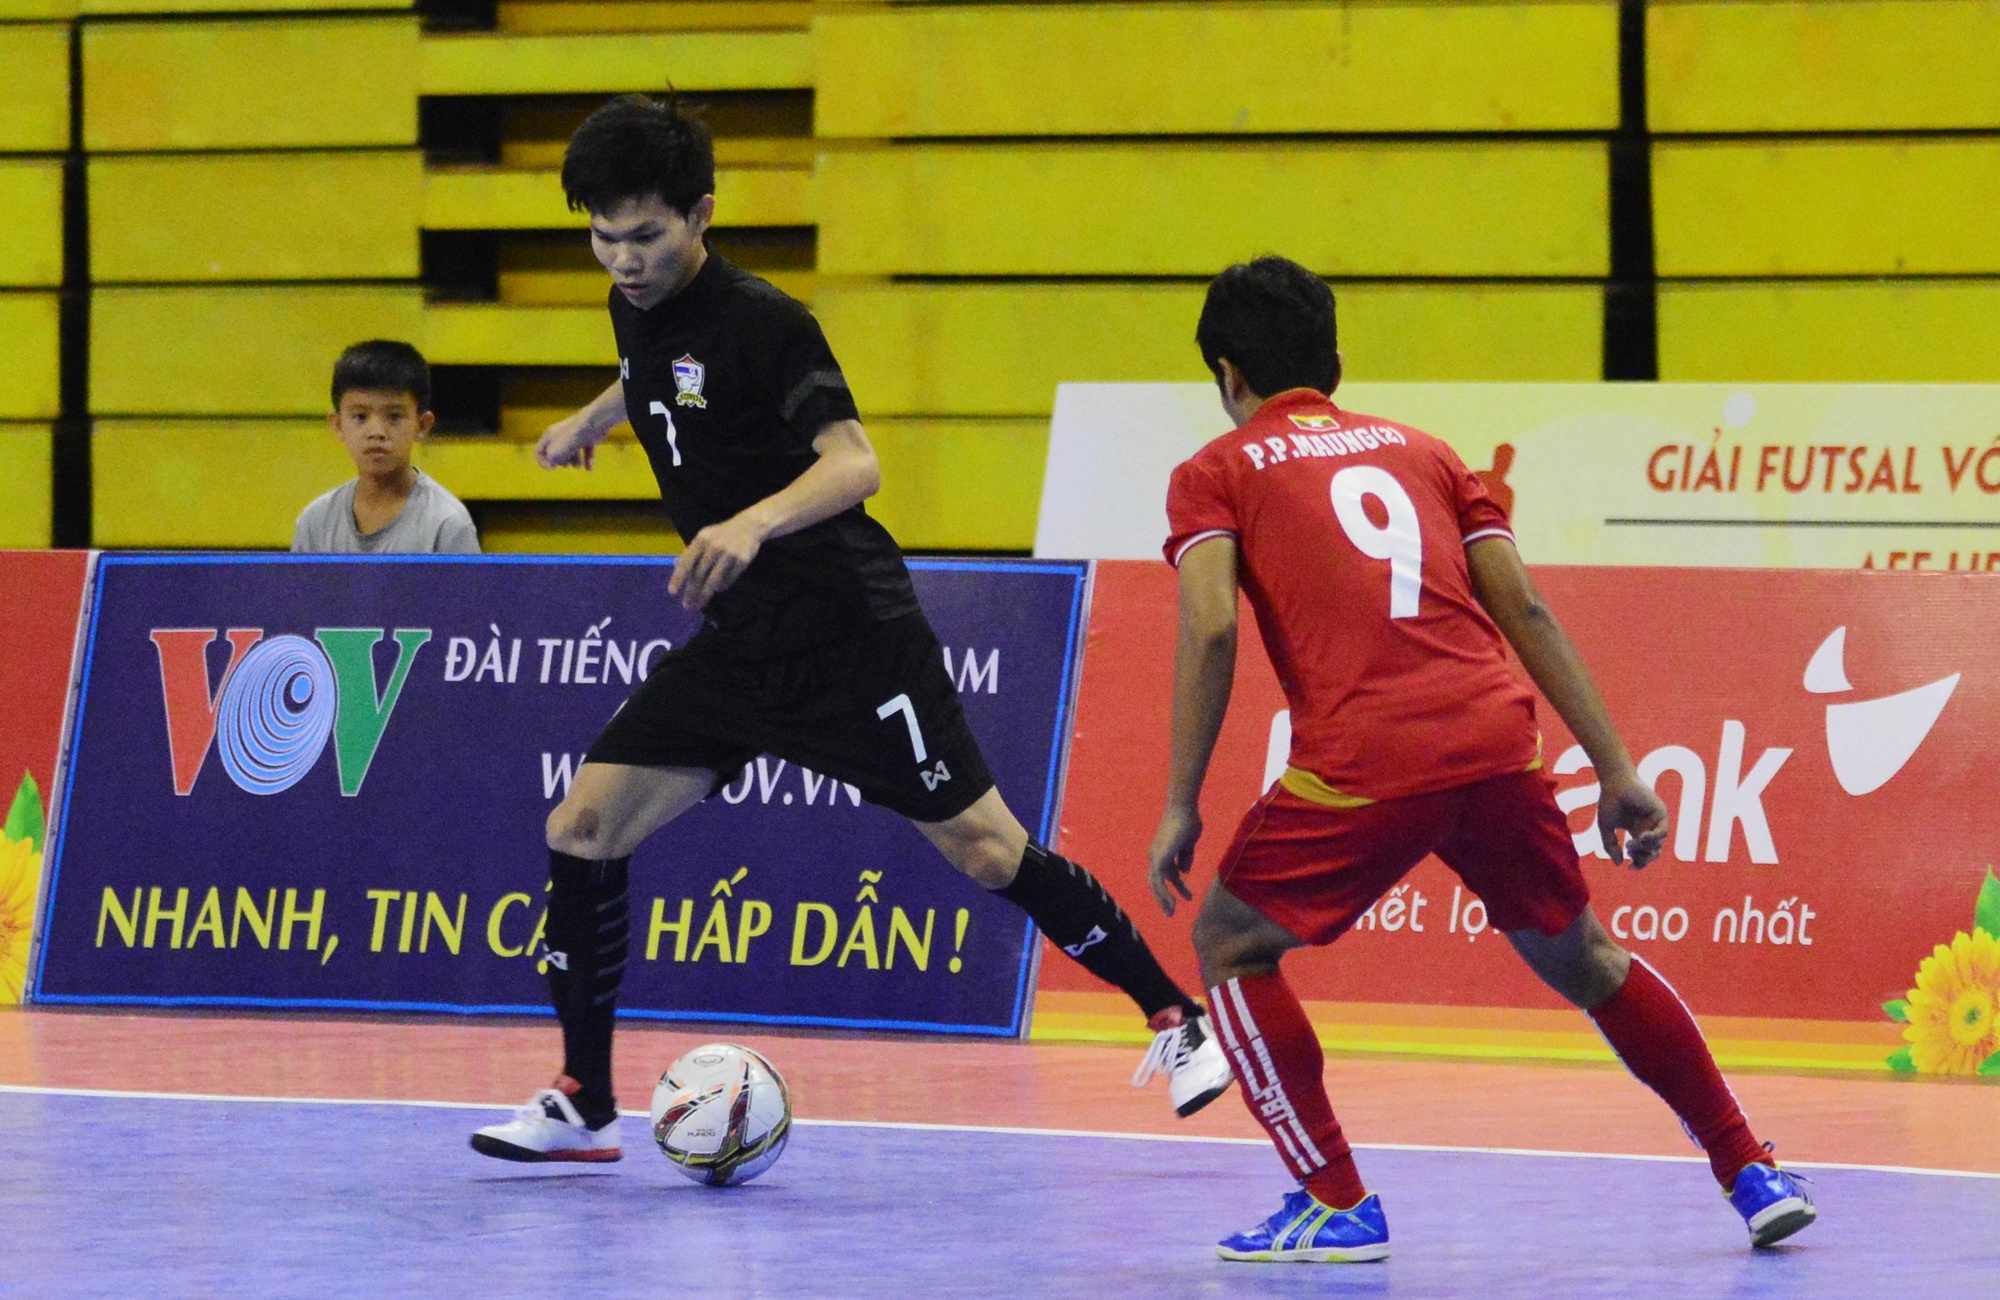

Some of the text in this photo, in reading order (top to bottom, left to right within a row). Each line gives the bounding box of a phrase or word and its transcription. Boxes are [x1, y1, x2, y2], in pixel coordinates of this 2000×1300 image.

[649, 401, 682, 467] 7
[1242, 425, 1407, 470] P.P.MAUNG(2)
[1646, 428, 1741, 493] GIẢI
[1756, 445, 1922, 494] FUTSAL
[1330, 465, 1422, 619] 9
[444, 624, 520, 683] ĐÀI
[150, 628, 432, 797] VOV
[876, 693, 927, 763] 7
[96, 886, 339, 966] NHANH,
[366, 890, 467, 956] TIN
[645, 867, 773, 964] HẤP
[790, 869, 936, 972] DẪN
[1611, 902, 1689, 943] cao
[1712, 896, 1816, 947] nhất
